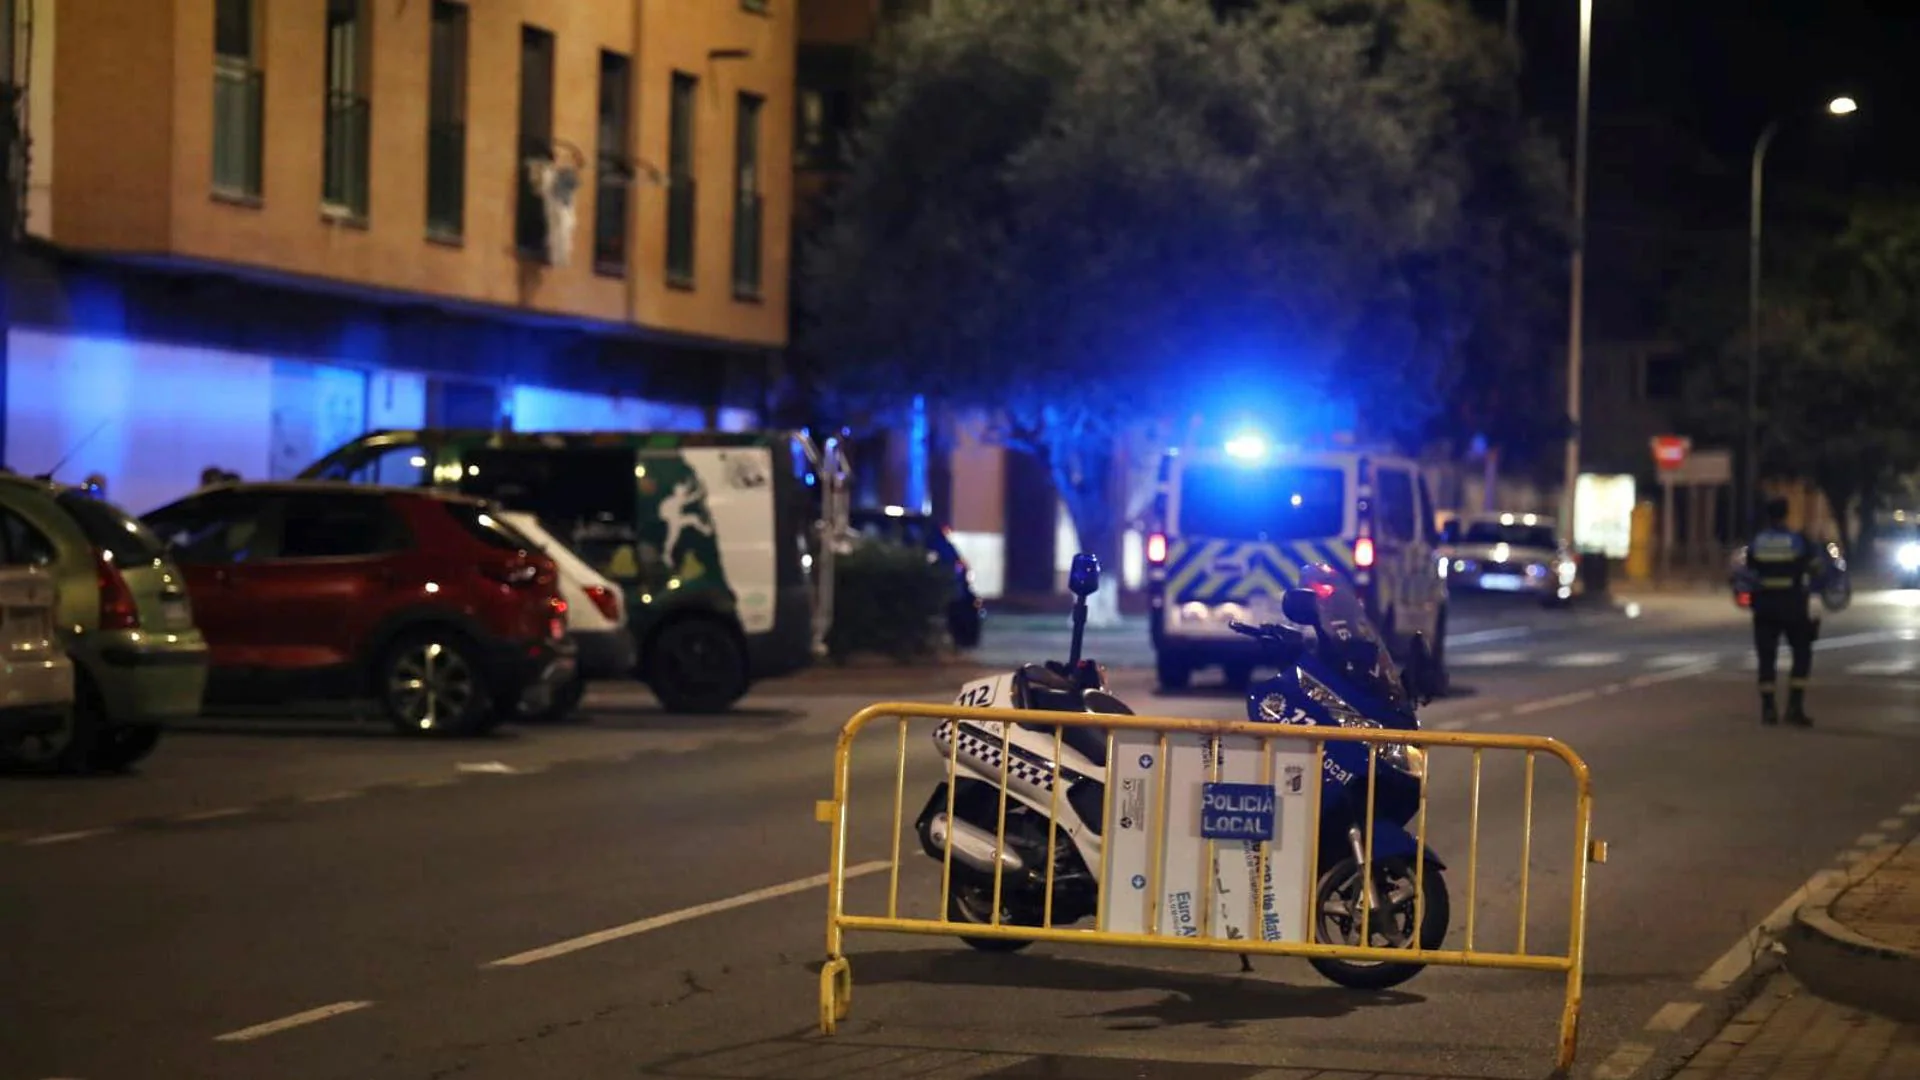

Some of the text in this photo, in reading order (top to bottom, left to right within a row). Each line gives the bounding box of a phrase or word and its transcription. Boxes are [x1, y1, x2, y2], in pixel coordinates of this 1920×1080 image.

[959, 684, 990, 707] 112
[1323, 752, 1353, 785] ocal
[1201, 794, 1274, 813] POLICIA
[1203, 815, 1269, 834] LOCAL
[1176, 892, 1192, 923] Euro
